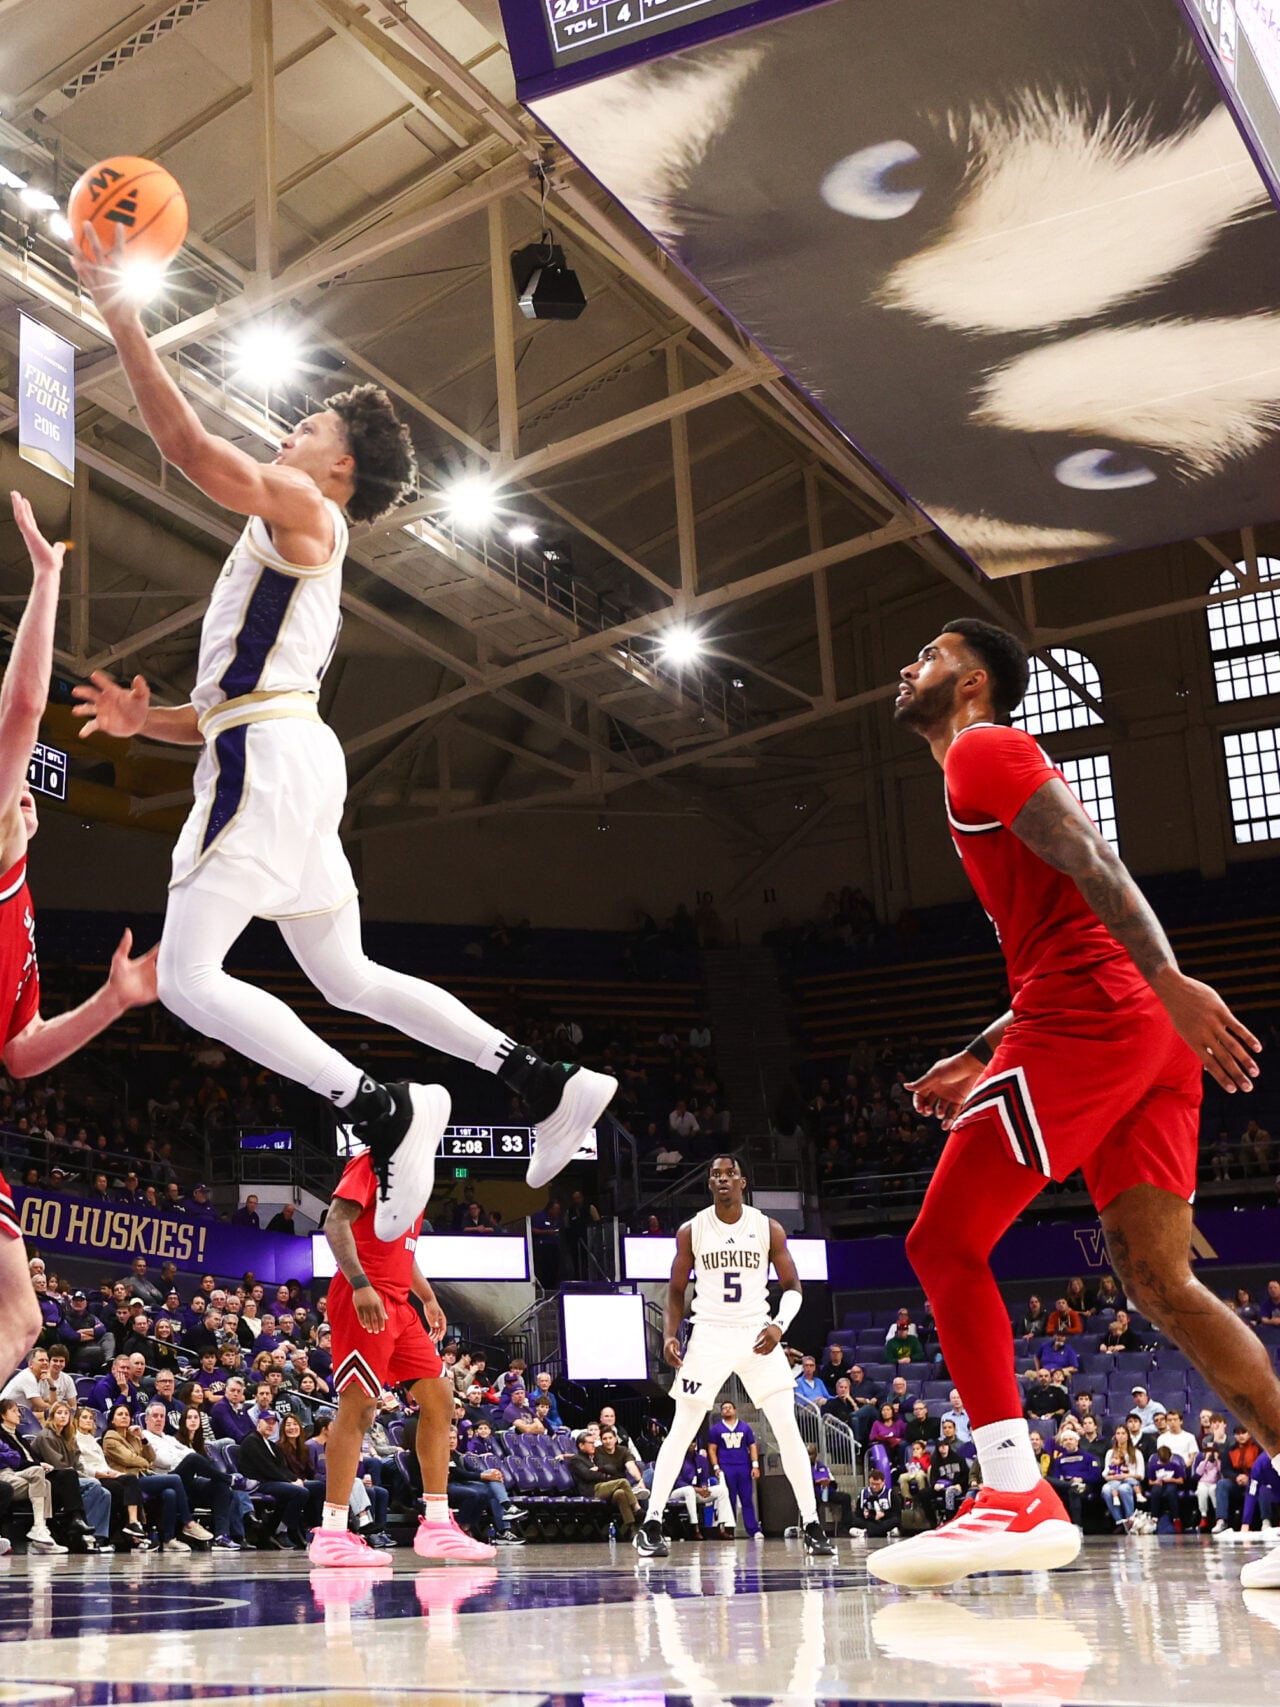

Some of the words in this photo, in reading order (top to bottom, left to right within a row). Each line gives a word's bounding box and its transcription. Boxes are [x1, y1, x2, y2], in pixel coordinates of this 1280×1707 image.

[564, 19, 598, 36] TOL
[617, 3, 632, 22] 4
[24, 362, 70, 403] FINAL
[25, 382, 69, 420] FOUR
[33, 413, 61, 442] 2016
[47, 751, 64, 766] STL
[29, 763, 36, 780] 1
[49, 774, 58, 788] 0
[764, 888, 776, 903] 11
[452, 1140, 483, 1154] 2:08
[501, 1135, 524, 1152] 33
[455, 1168, 467, 1178] EXIT
[21, 1197, 62, 1240] GO
[701, 1250, 761, 1271] HUSKIES
[723, 1272, 742, 1303] 5
[681, 1378, 702, 1395] W
[721, 1432, 744, 1449] W
